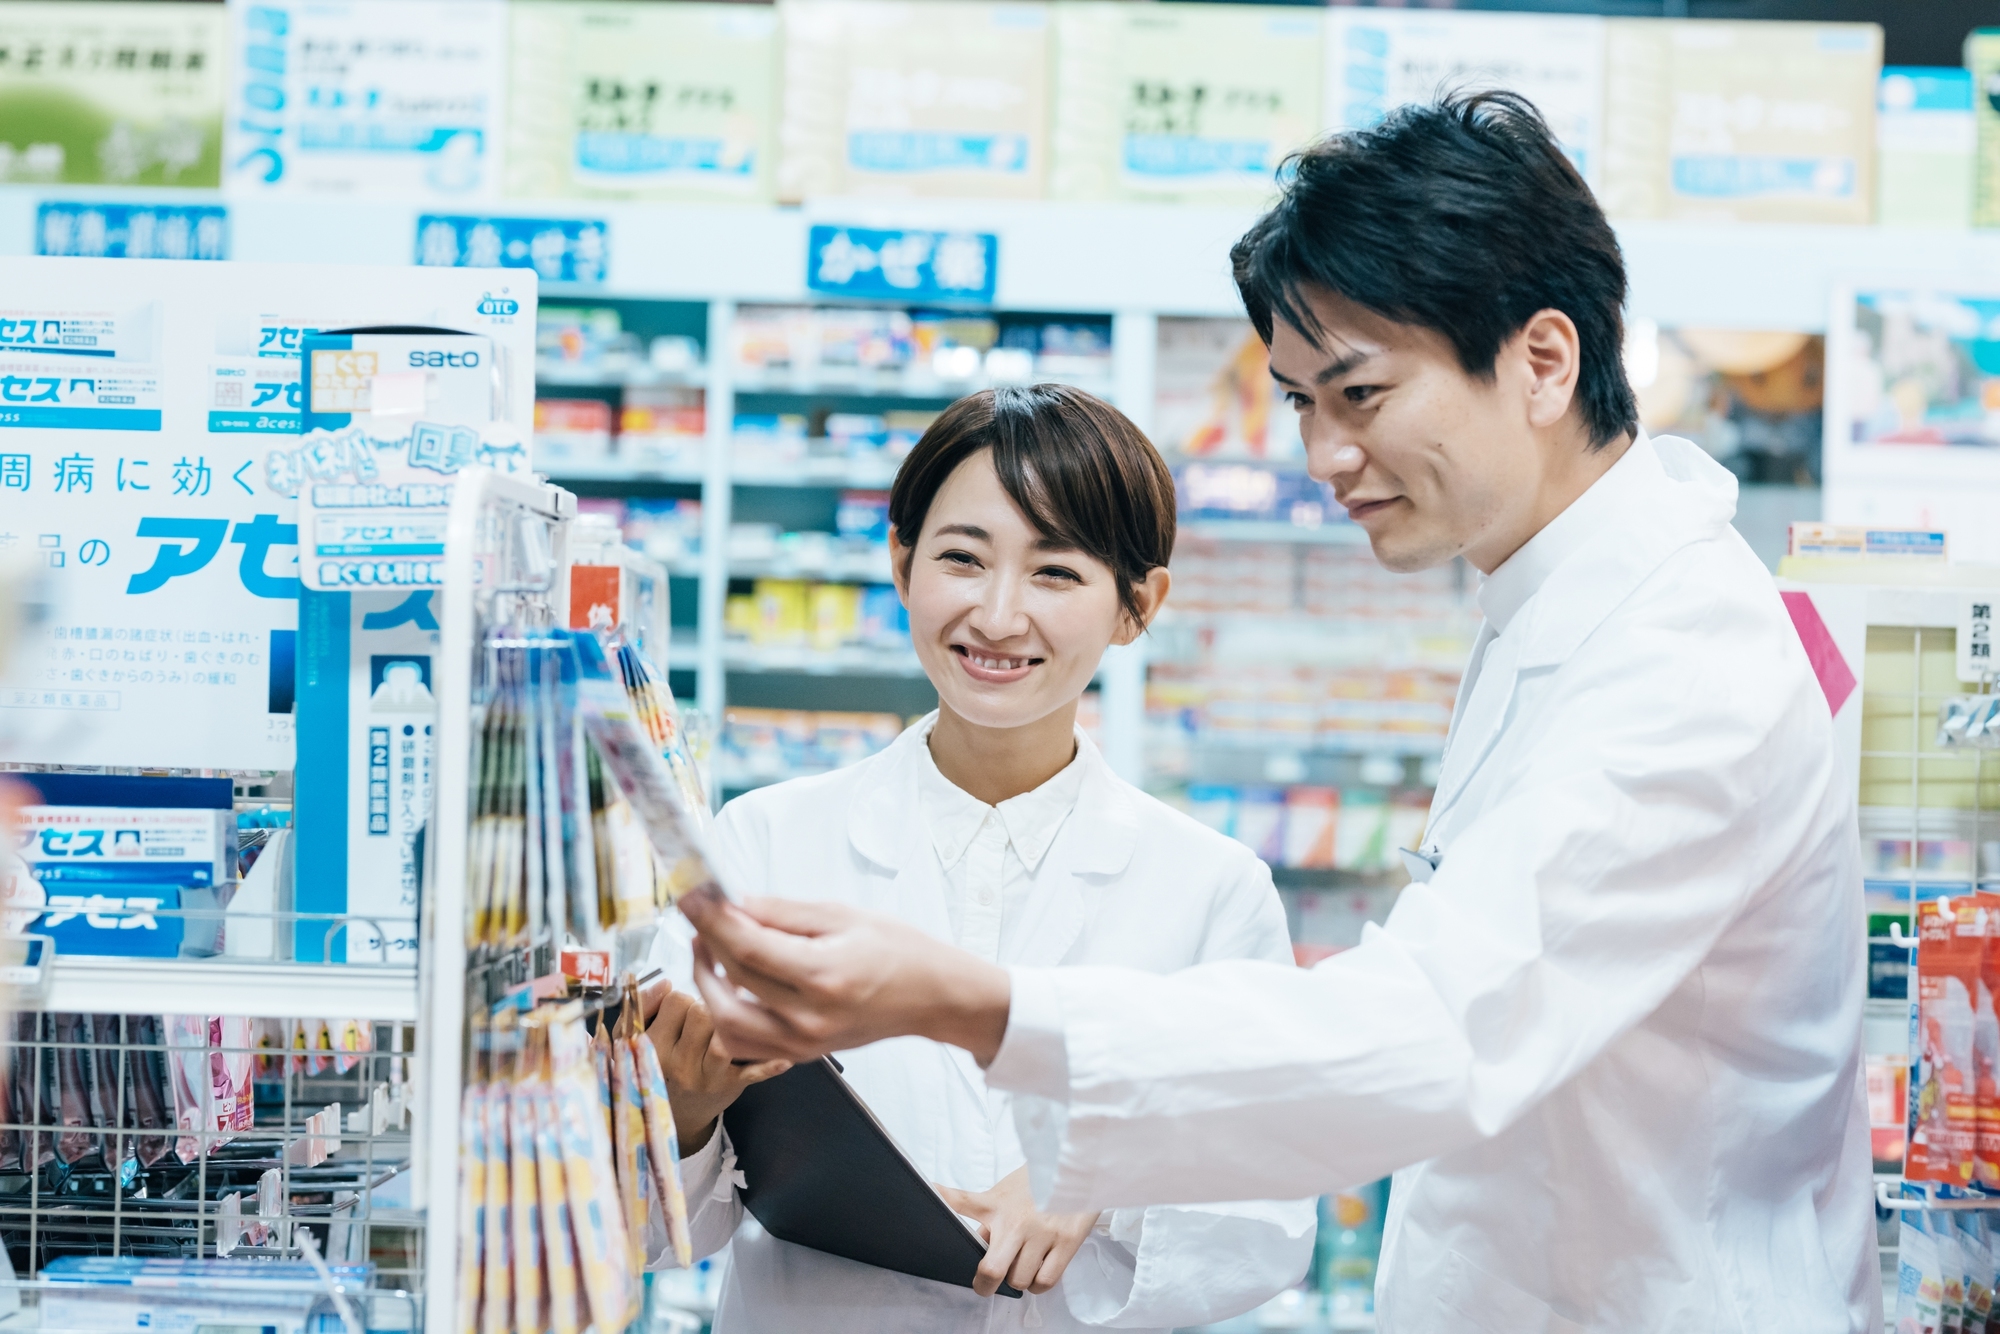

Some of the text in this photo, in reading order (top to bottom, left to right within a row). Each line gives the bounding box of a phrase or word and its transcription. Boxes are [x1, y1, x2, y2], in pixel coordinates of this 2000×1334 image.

[483, 300, 513, 314] OTC
[409, 351, 479, 368] sato
[0, 375, 61, 403] セス
[0, 452, 255, 497] 周病に効く
[1972, 604, 1990, 657] 第2類
[14, 691, 107, 707] 第2類医薬品
[45, 894, 159, 930] アセス
